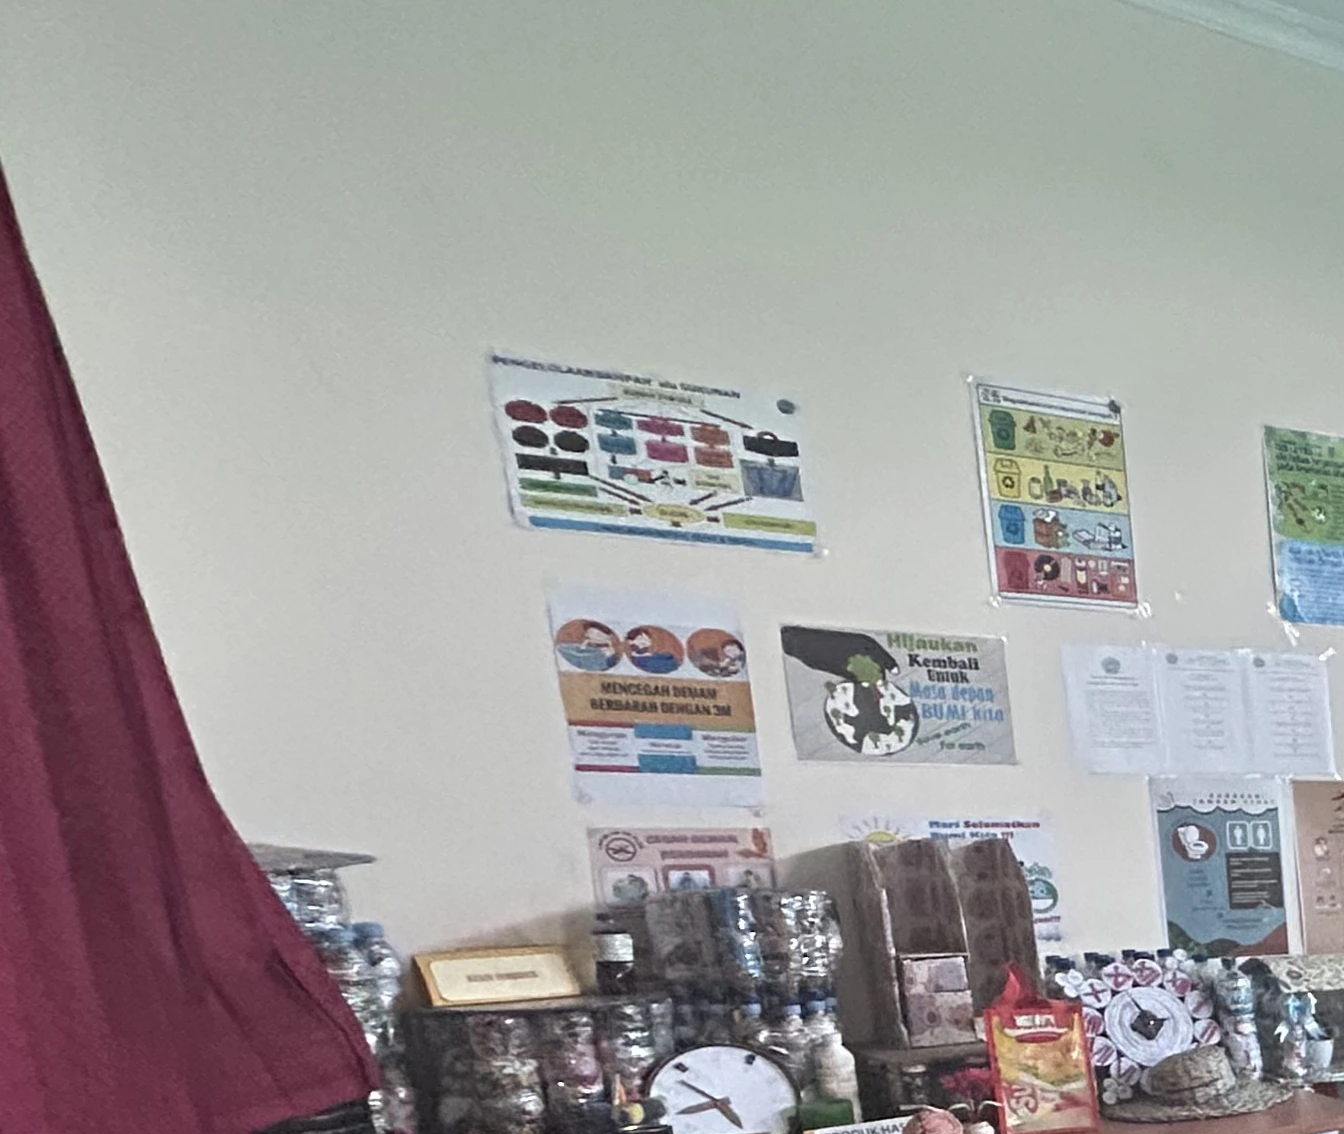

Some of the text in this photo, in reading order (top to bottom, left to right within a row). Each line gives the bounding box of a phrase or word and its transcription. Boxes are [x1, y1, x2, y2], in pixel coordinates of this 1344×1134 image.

[908, 653, 981, 671] Kembali
[921, 703, 966, 721] BUMI
[881, 1122, 905, 1134] HA
